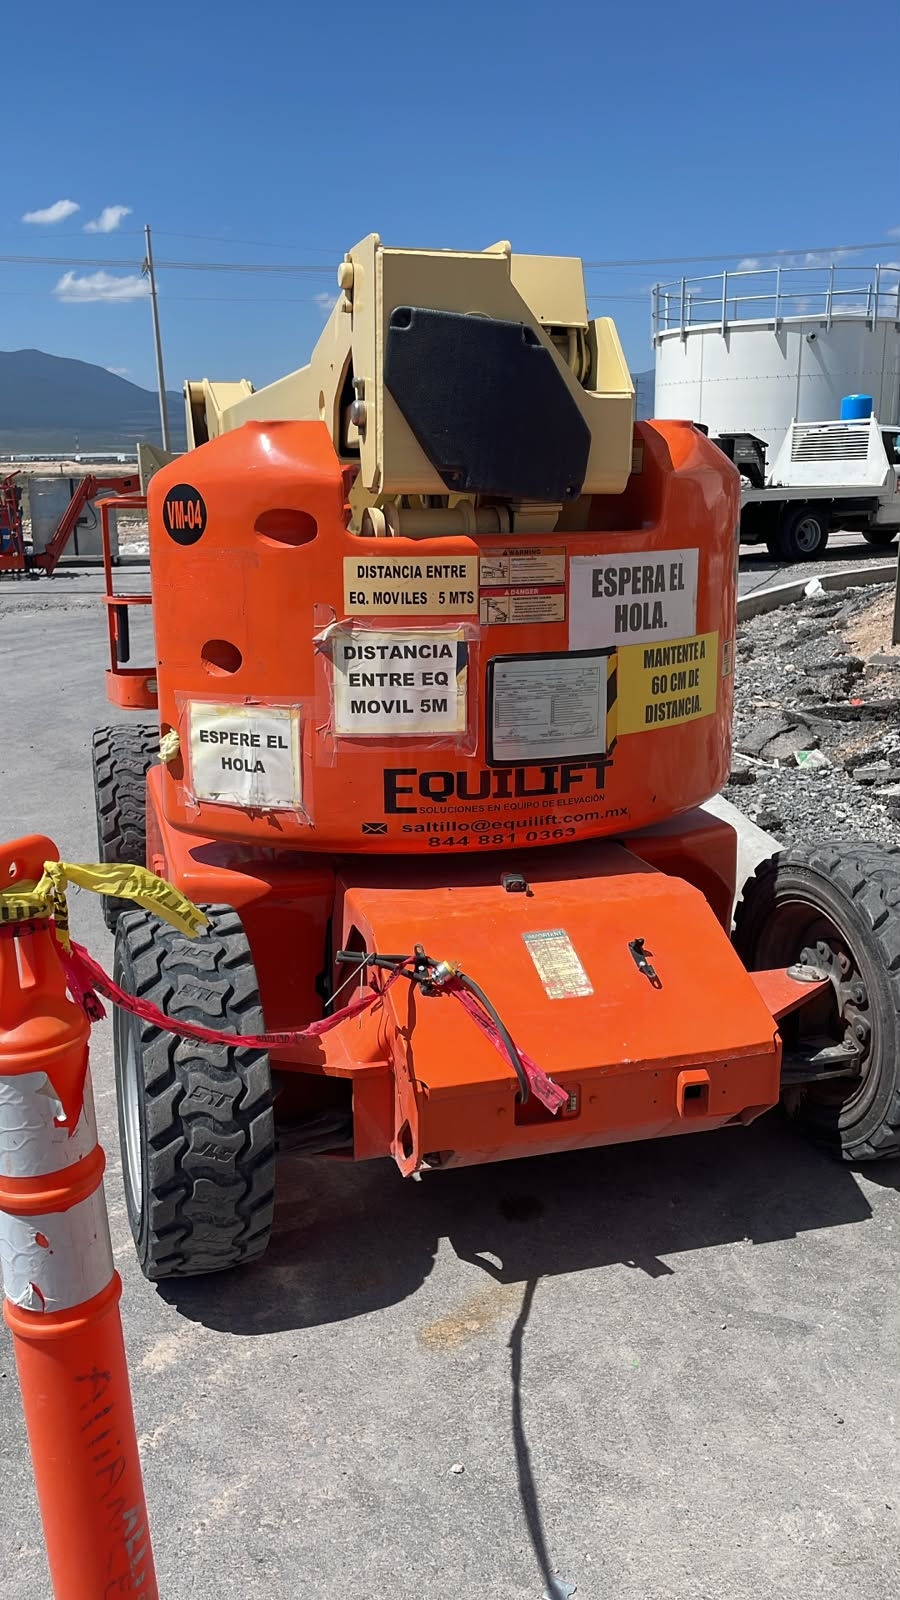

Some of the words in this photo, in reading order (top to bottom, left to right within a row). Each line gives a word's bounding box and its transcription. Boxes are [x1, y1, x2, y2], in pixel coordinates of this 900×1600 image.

[167, 500, 202, 529] VM-04
[357, 565, 422, 578] DISTANCIA
[426, 565, 466, 578] ENTRE
[592, 564, 665, 598] ESPERA
[669, 562, 685, 592] EL
[350, 592, 368, 605] EQ.
[373, 592, 427, 604] MOVILES
[438, 591, 445, 603] 5
[449, 591, 474, 603] MTS
[510, 588, 539, 596] DANGER
[614, 600, 668, 633] HOLA.
[343, 644, 453, 660] DISTANCIA
[643, 642, 699, 669] MANTENTE
[699, 640, 706, 659] A
[349, 673, 414, 687] ENTRE
[422, 671, 448, 686] EQ
[651, 674, 668, 696] 60
[670, 670, 686, 692] CM
[688, 668, 700, 688] DE
[351, 699, 413, 714] MOVIL
[420, 699, 447, 713] 5M
[645, 695, 702, 724] DISTANCIA.
[199, 730, 260, 747] ESPERE
[267, 735, 288, 749] EL
[221, 757, 266, 773] HOLA
[384, 759, 614, 814] EQUILIFT
[420, 804, 484, 814] SOLUCIONES
[487, 803, 500, 812] EN
[504, 801, 539, 811] EQUIPO
[542, 799, 554, 808] DE
[557, 793, 605, 807] ELEVACIÓN
[402, 807, 628, 832] saltillo@equilift.com.mx
[428, 835, 470, 847] 844
[478, 832, 516, 845] 881
[526, 827, 577, 842] 0363
